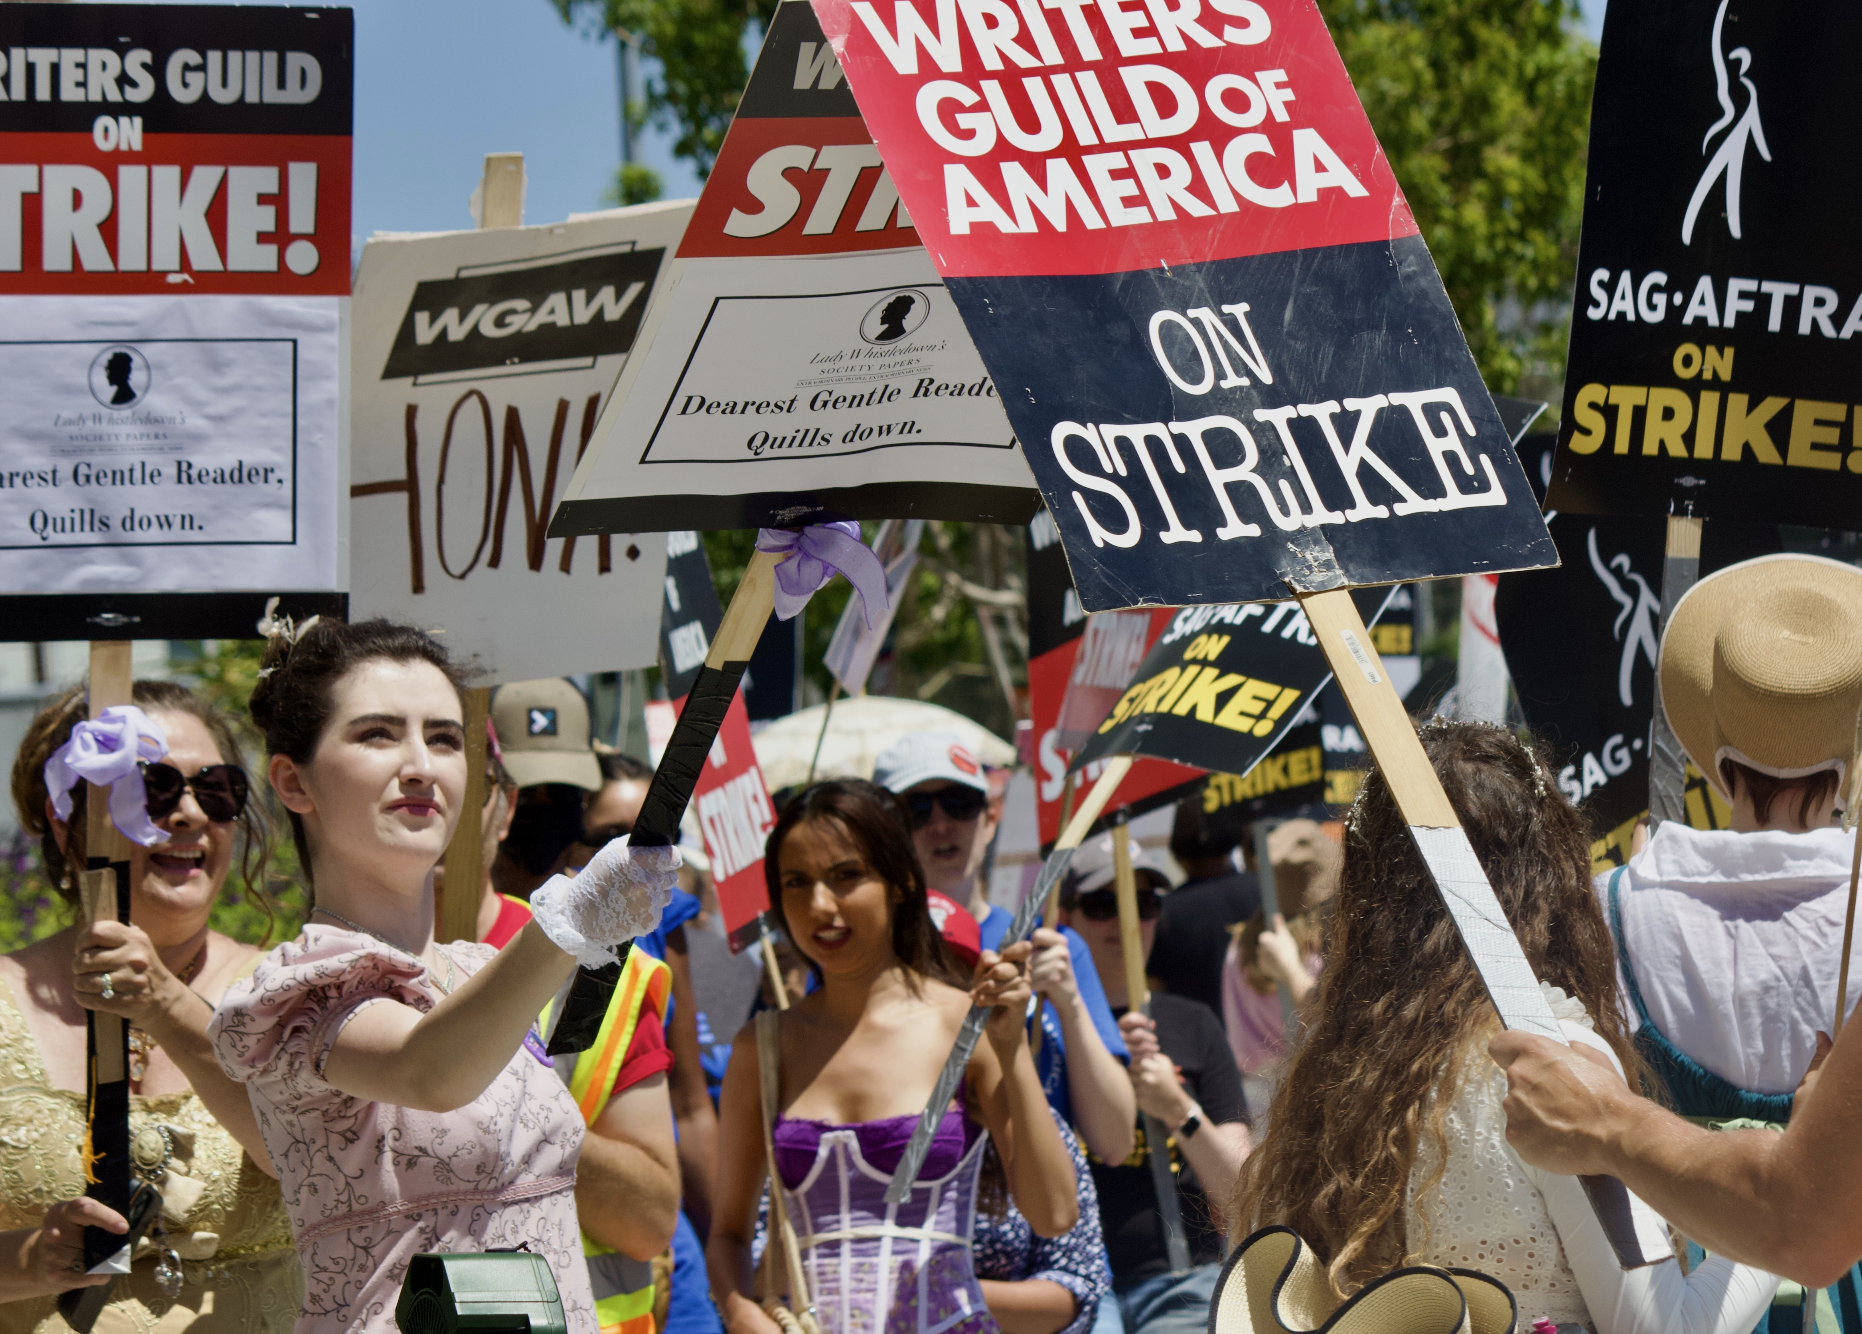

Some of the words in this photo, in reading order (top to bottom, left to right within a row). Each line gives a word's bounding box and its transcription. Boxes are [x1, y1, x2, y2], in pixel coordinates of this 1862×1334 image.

[851, 0, 1273, 75] WRITERS
[165, 48, 322, 104] GUILD
[915, 63, 1199, 156] GUILD
[1205, 68, 1296, 127] OF
[93, 115, 142, 151] ON
[944, 127, 1370, 235] AMERICA
[414, 281, 645, 346] WGAW
[809, 350, 848, 365] Lady
[819, 364, 874, 376] SOCIETY
[878, 357, 922, 371] PAPERS
[1148, 302, 1273, 396] ON
[1672, 342, 1735, 382] ON
[677, 394, 798, 416] Dearest
[809, 383, 901, 412] Gentle
[747, 427, 833, 456] Quills
[842, 420, 923, 444] down.
[72, 460, 162, 488] Gentle
[175, 459, 284, 490] Reader,
[1050, 387, 1507, 548] STRIKE
[29, 508, 111, 541] Quills
[121, 507, 204, 533] down.
[1183, 633, 1231, 661] ON
[1098, 664, 1301, 737] STRIKE!
